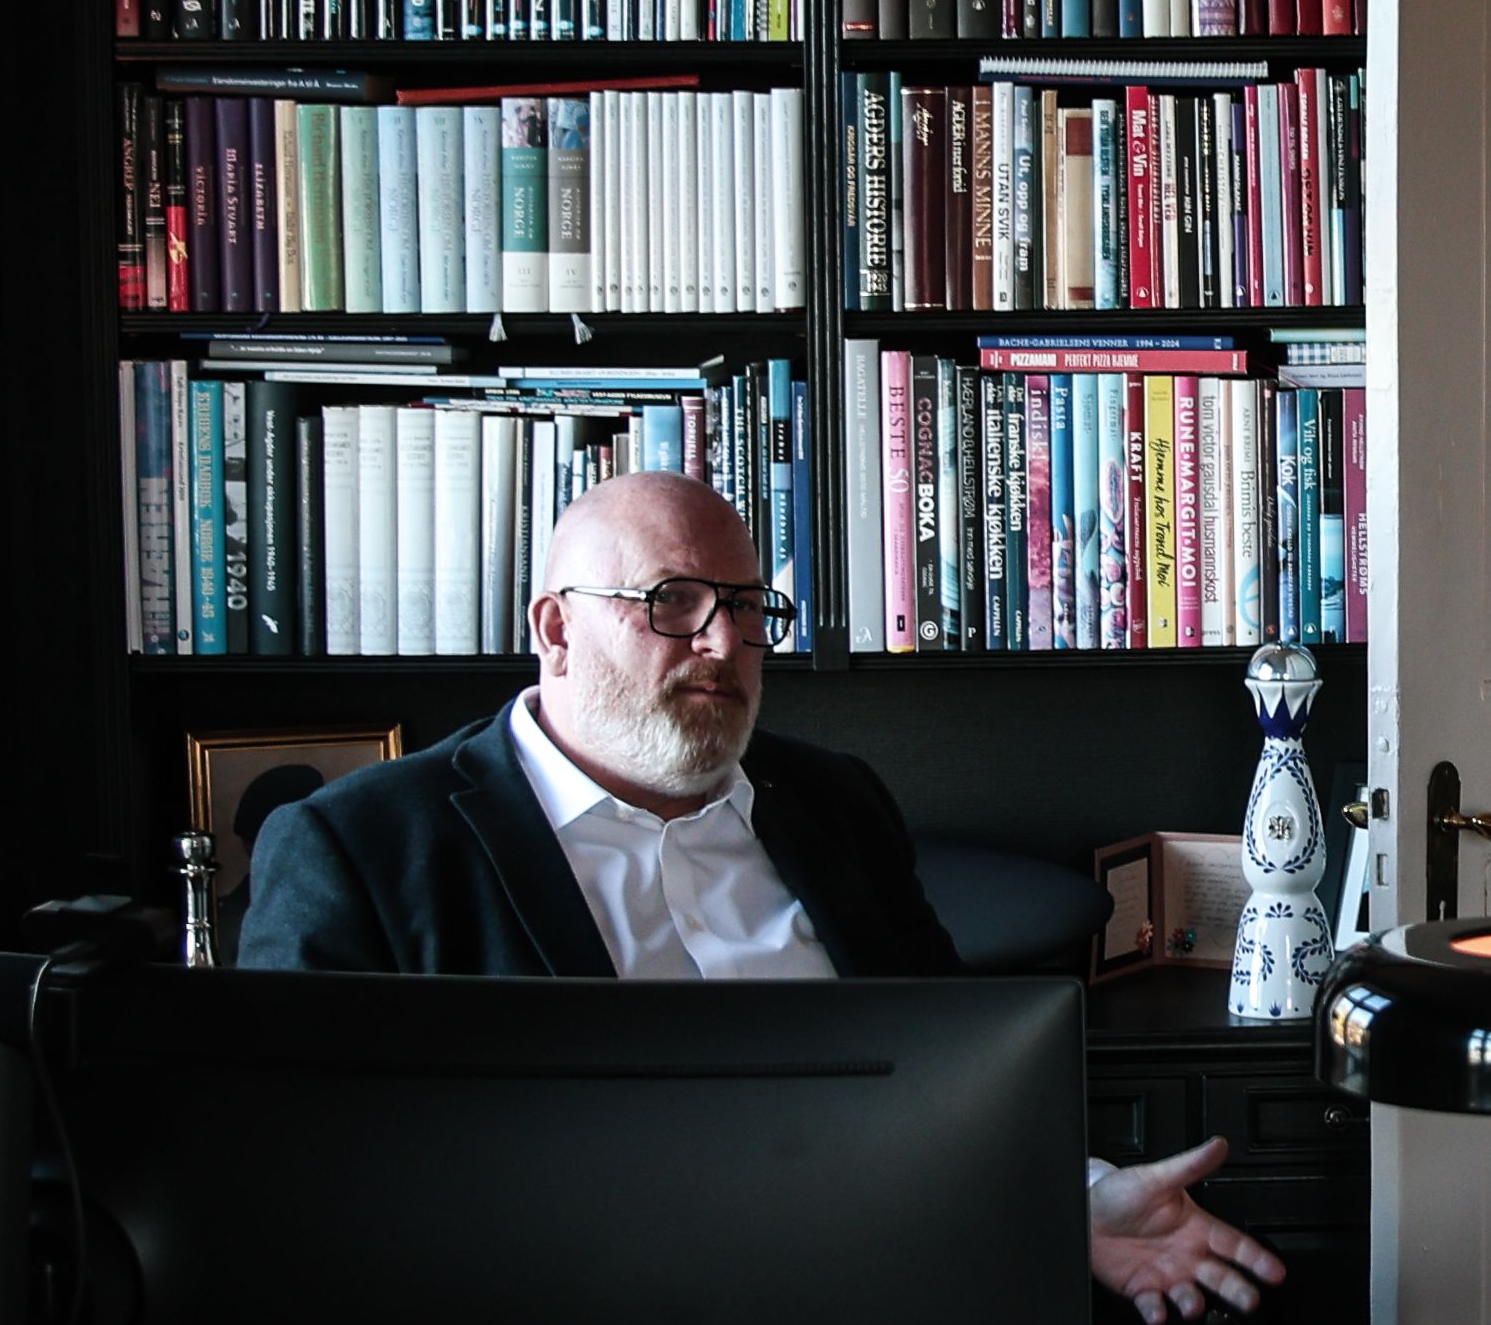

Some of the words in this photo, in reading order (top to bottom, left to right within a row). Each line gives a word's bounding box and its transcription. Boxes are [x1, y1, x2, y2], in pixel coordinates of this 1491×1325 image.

[864, 90, 886, 169] AGDERS
[999, 164, 1009, 202] UTAN
[1018, 155, 1031, 178] Ut,
[514, 187, 525, 238] NORGE
[561, 187, 572, 240] NORGE
[1017, 182, 1029, 209] opp
[865, 174, 887, 266] HISTORIE
[999, 209, 1009, 240] SVIK
[1017, 213, 1028, 232] og
[1019, 236, 1031, 271] fram
[889, 386, 905, 459] BESTE
[1031, 389, 1047, 461] indisk!
[1055, 387, 1068, 430] Pasta
[1202, 396, 1215, 420] tom
[1008, 413, 1023, 468] franske
[1202, 424, 1217, 458] victor
[1303, 419, 1316, 442] Vilt
[987, 409, 1003, 497] italienske
[1131, 432, 1142, 482] KRAFT
[1149, 438, 1170, 492] Hjemme
[1281, 455, 1295, 486] Kok
[1301, 447, 1313, 465] og
[1199, 463, 1219, 512] gausdal
[1241, 471, 1254, 517] Brimis
[1303, 468, 1316, 490] fisk
[1005, 471, 1023, 531] kjøkken
[1153, 496, 1168, 518] hos
[986, 504, 1004, 579] kjøkken
[1155, 522, 1174, 559] Trond
[1203, 516, 1219, 603] husmannskost
[1242, 522, 1255, 558] beste
[226, 551, 246, 611] 1940
[1156, 562, 1170, 587] Moi
